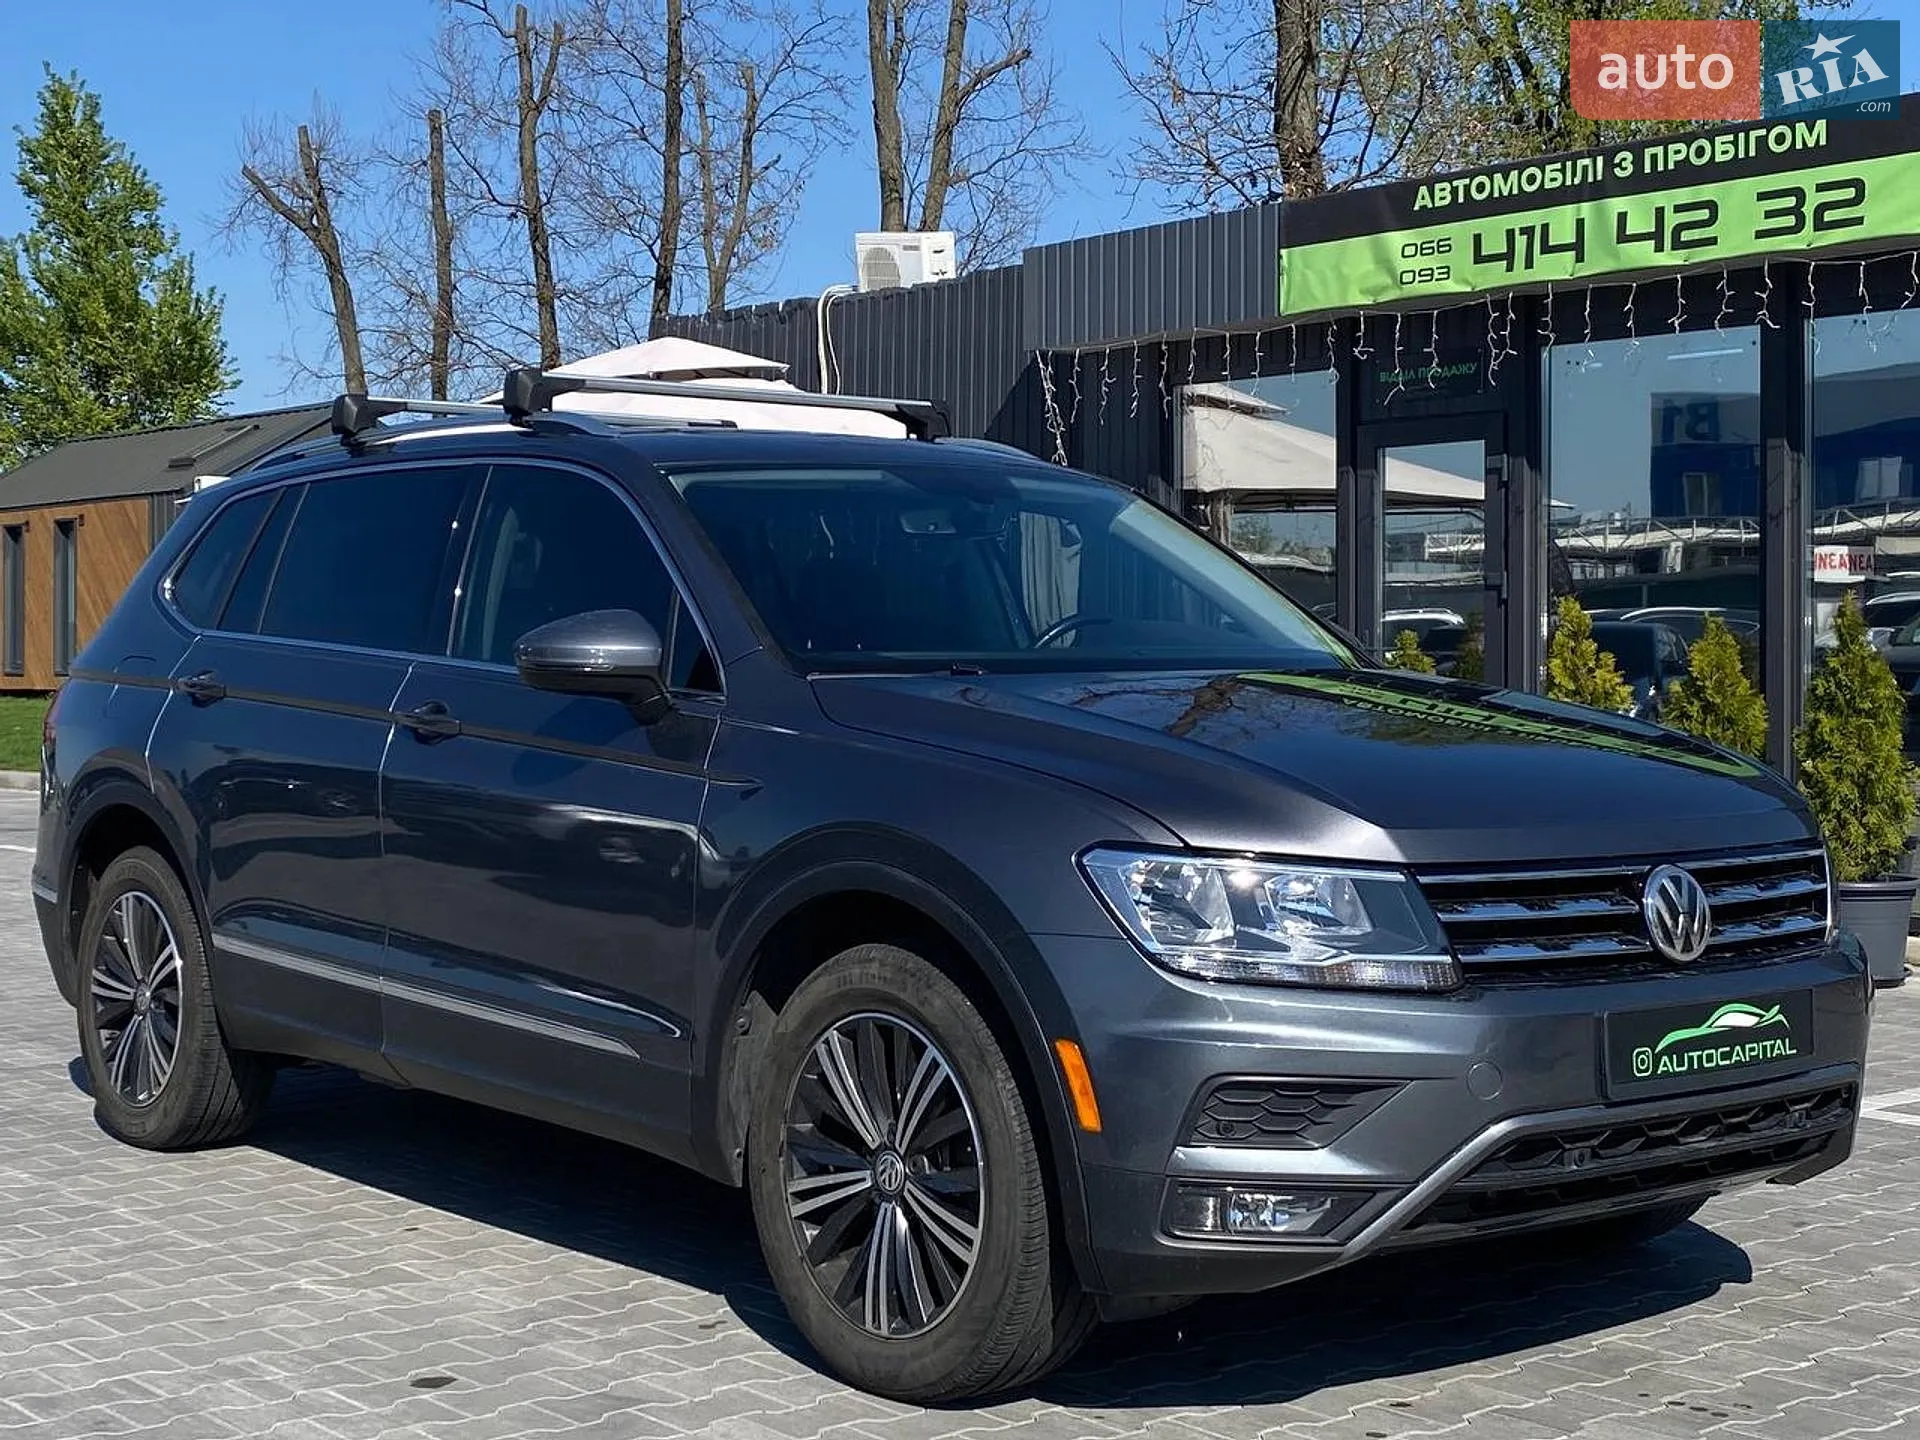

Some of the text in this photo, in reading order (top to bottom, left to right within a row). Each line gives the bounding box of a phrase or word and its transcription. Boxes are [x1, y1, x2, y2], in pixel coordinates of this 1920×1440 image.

[1413, 119, 1828, 211] АВТОМОБІЛІ З ПРОБІГОМ
[1472, 177, 1866, 273] 414 42 32
[1400, 236, 1452, 258] 066
[1400, 265, 1451, 285] 093
[1657, 1038, 1798, 1075] AUTOCAPITAL
